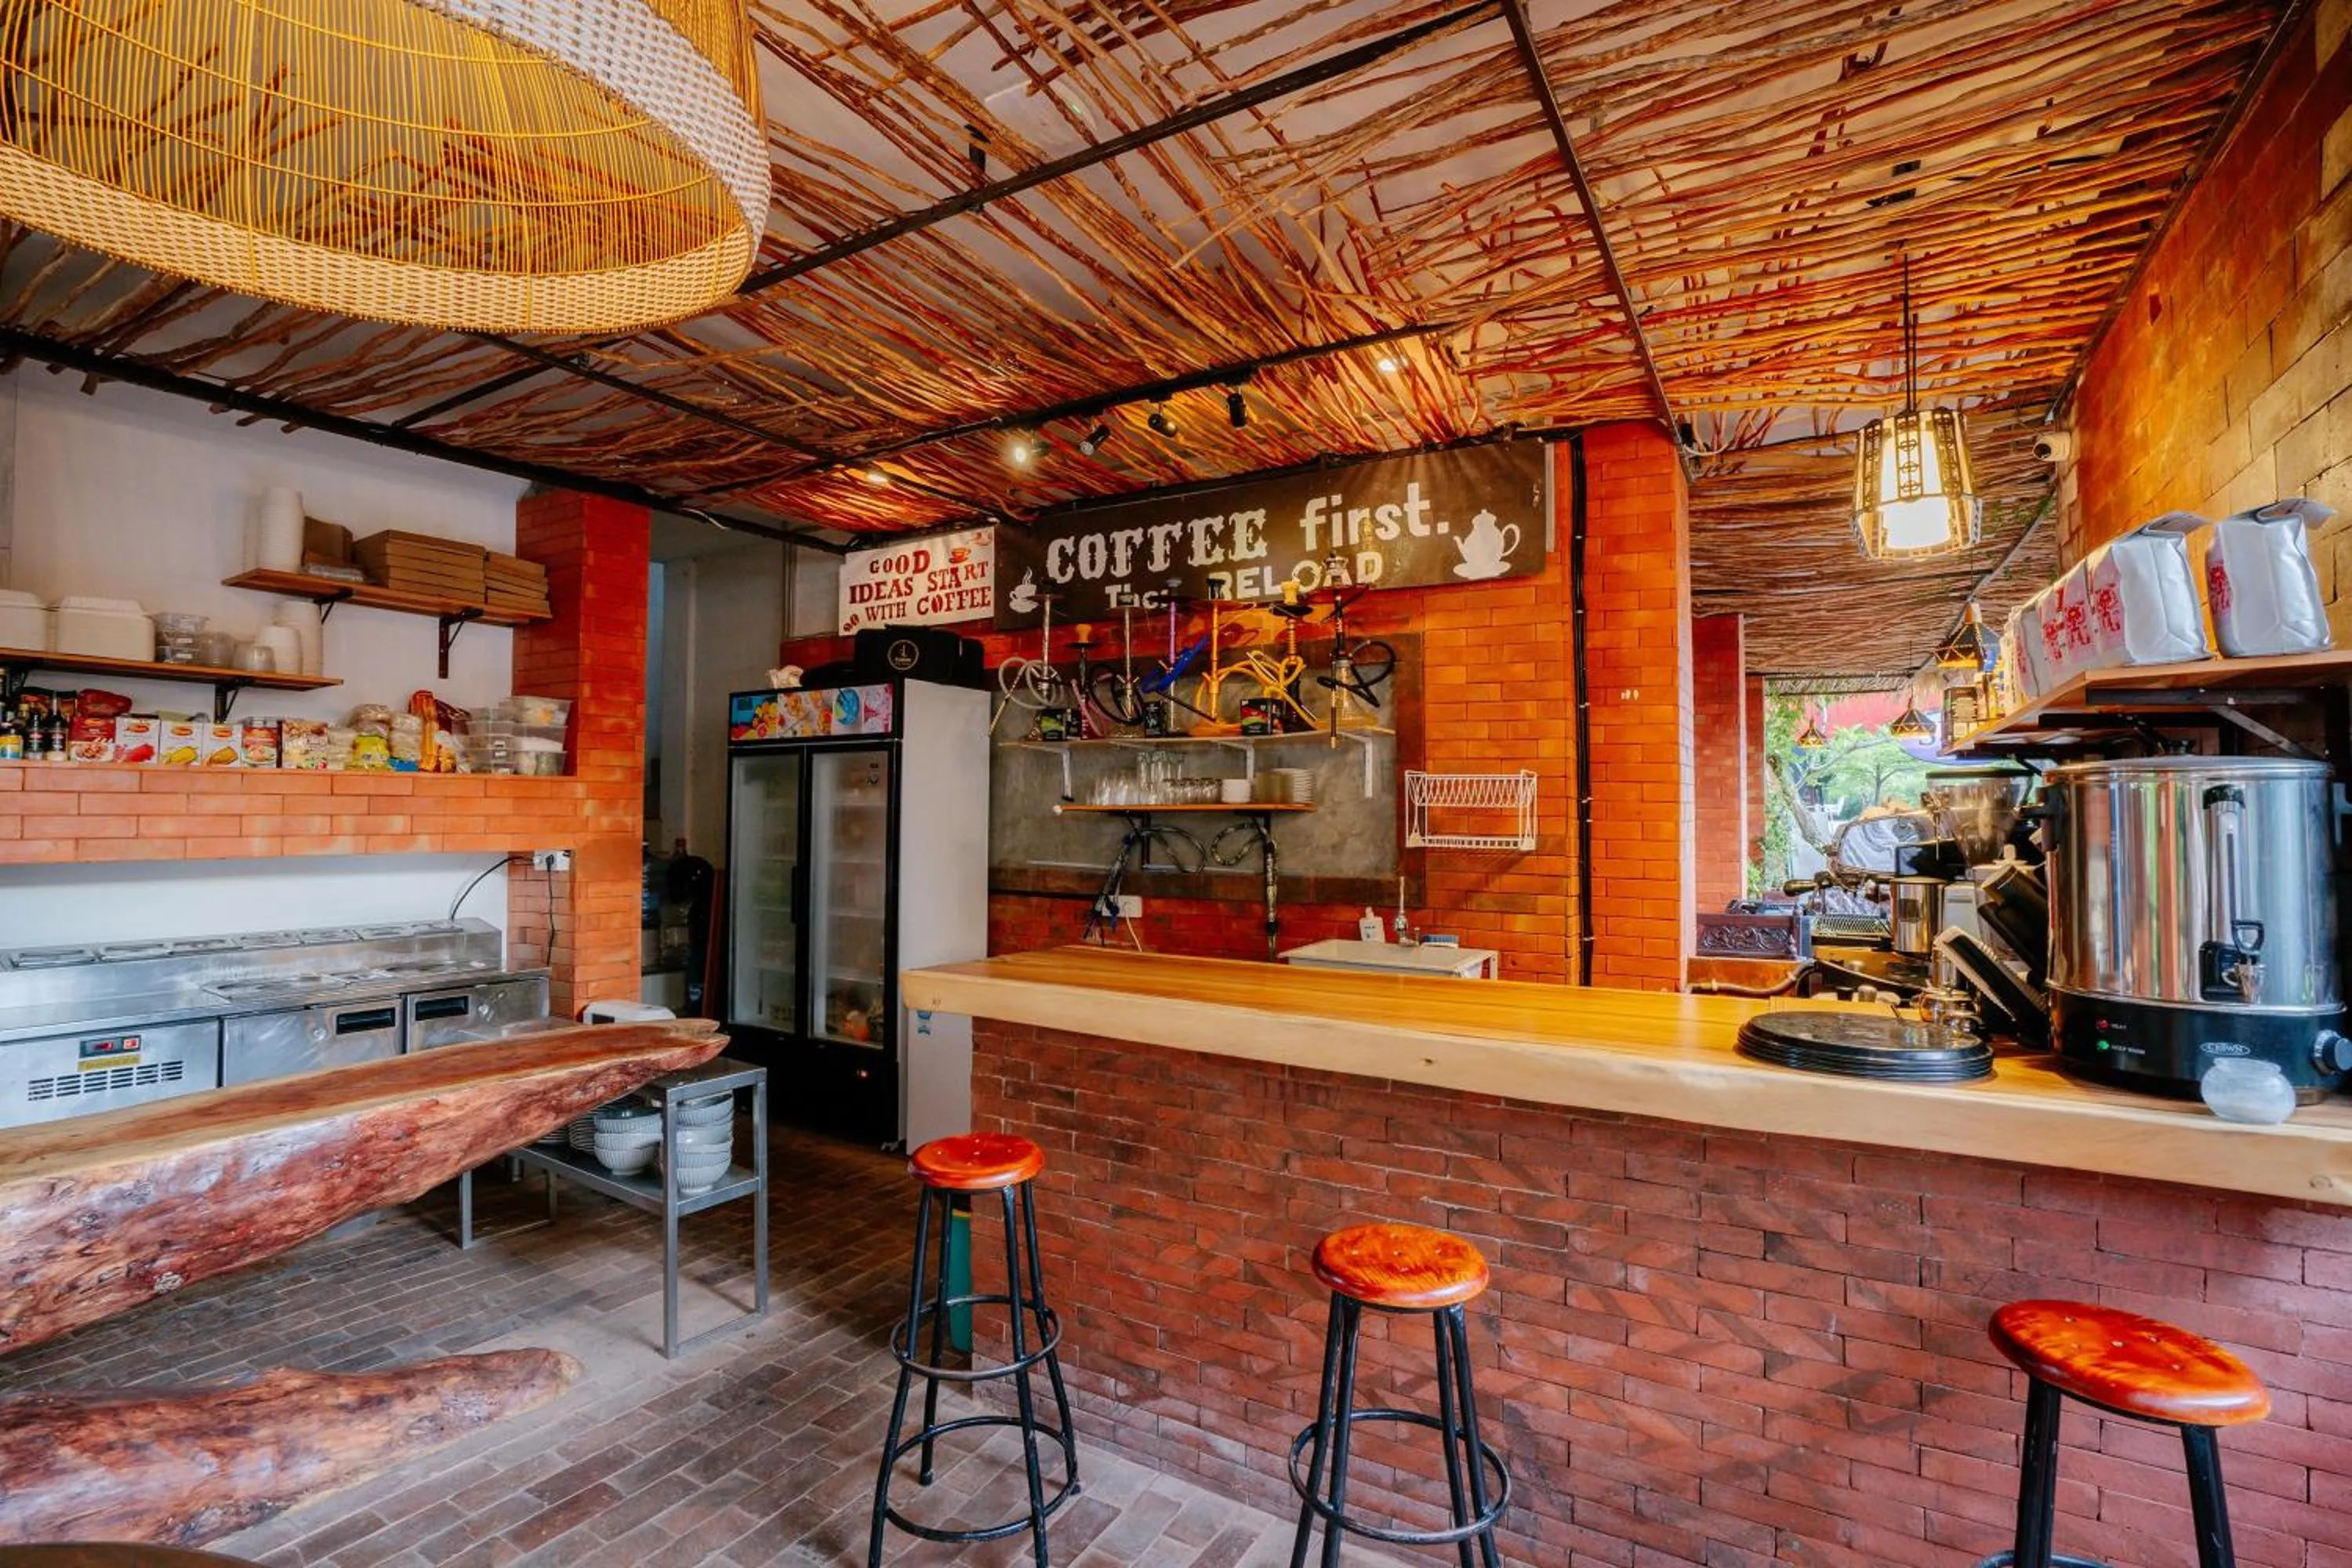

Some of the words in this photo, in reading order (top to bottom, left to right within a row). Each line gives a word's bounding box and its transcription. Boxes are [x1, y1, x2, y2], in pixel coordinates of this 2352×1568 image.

[1046, 508, 1267, 584] COFFEE
[1299, 482, 1449, 551] first.
[849, 577, 913, 604] IDEAS
[928, 561, 989, 593] START
[869, 550, 931, 574] GOOD
[1208, 551, 1382, 601] RELOAD
[866, 601, 906, 622] WITH
[916, 586, 992, 615] COFFEE
